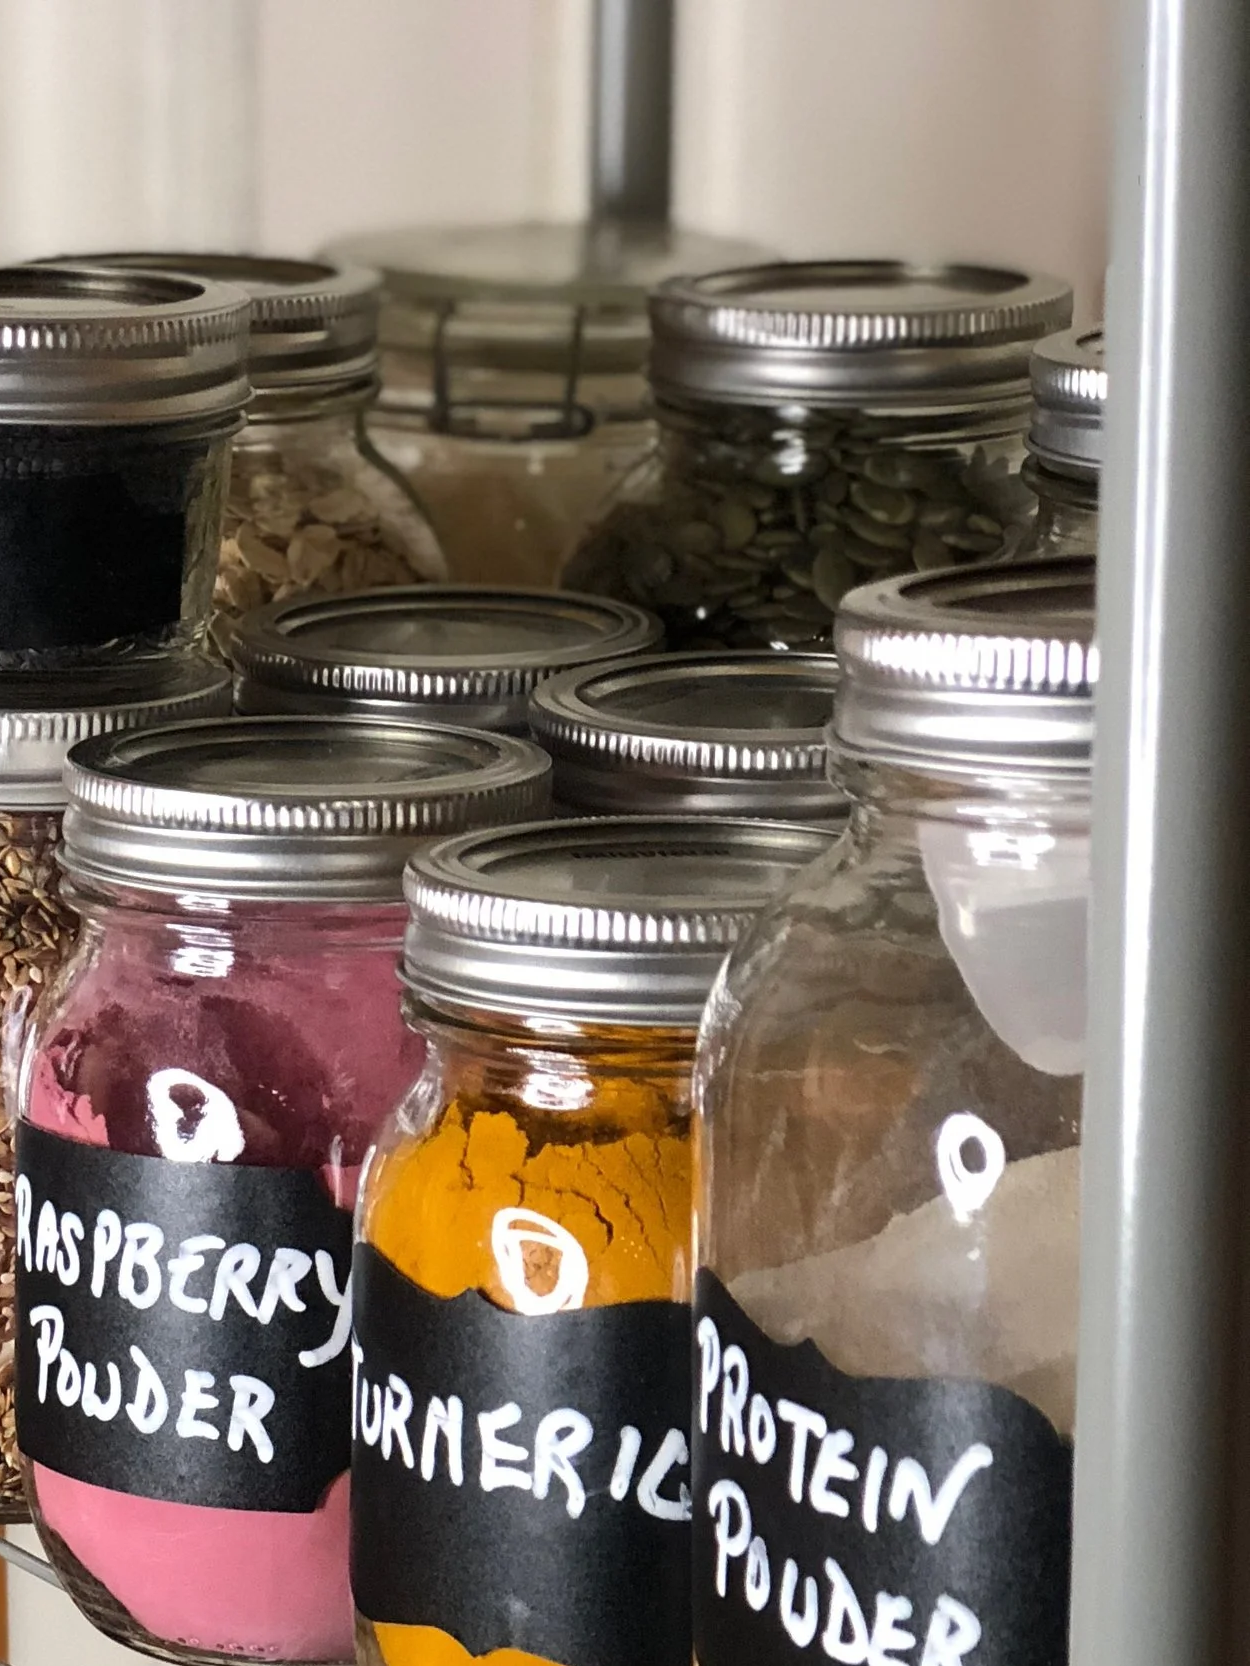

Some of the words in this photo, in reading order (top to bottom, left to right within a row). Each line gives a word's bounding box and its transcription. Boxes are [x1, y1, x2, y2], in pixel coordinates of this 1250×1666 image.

[15, 1173, 352, 1368] RASPBERRY
[30, 1305, 275, 1464] POWDER
[697, 1316, 993, 1545] PROTEIN
